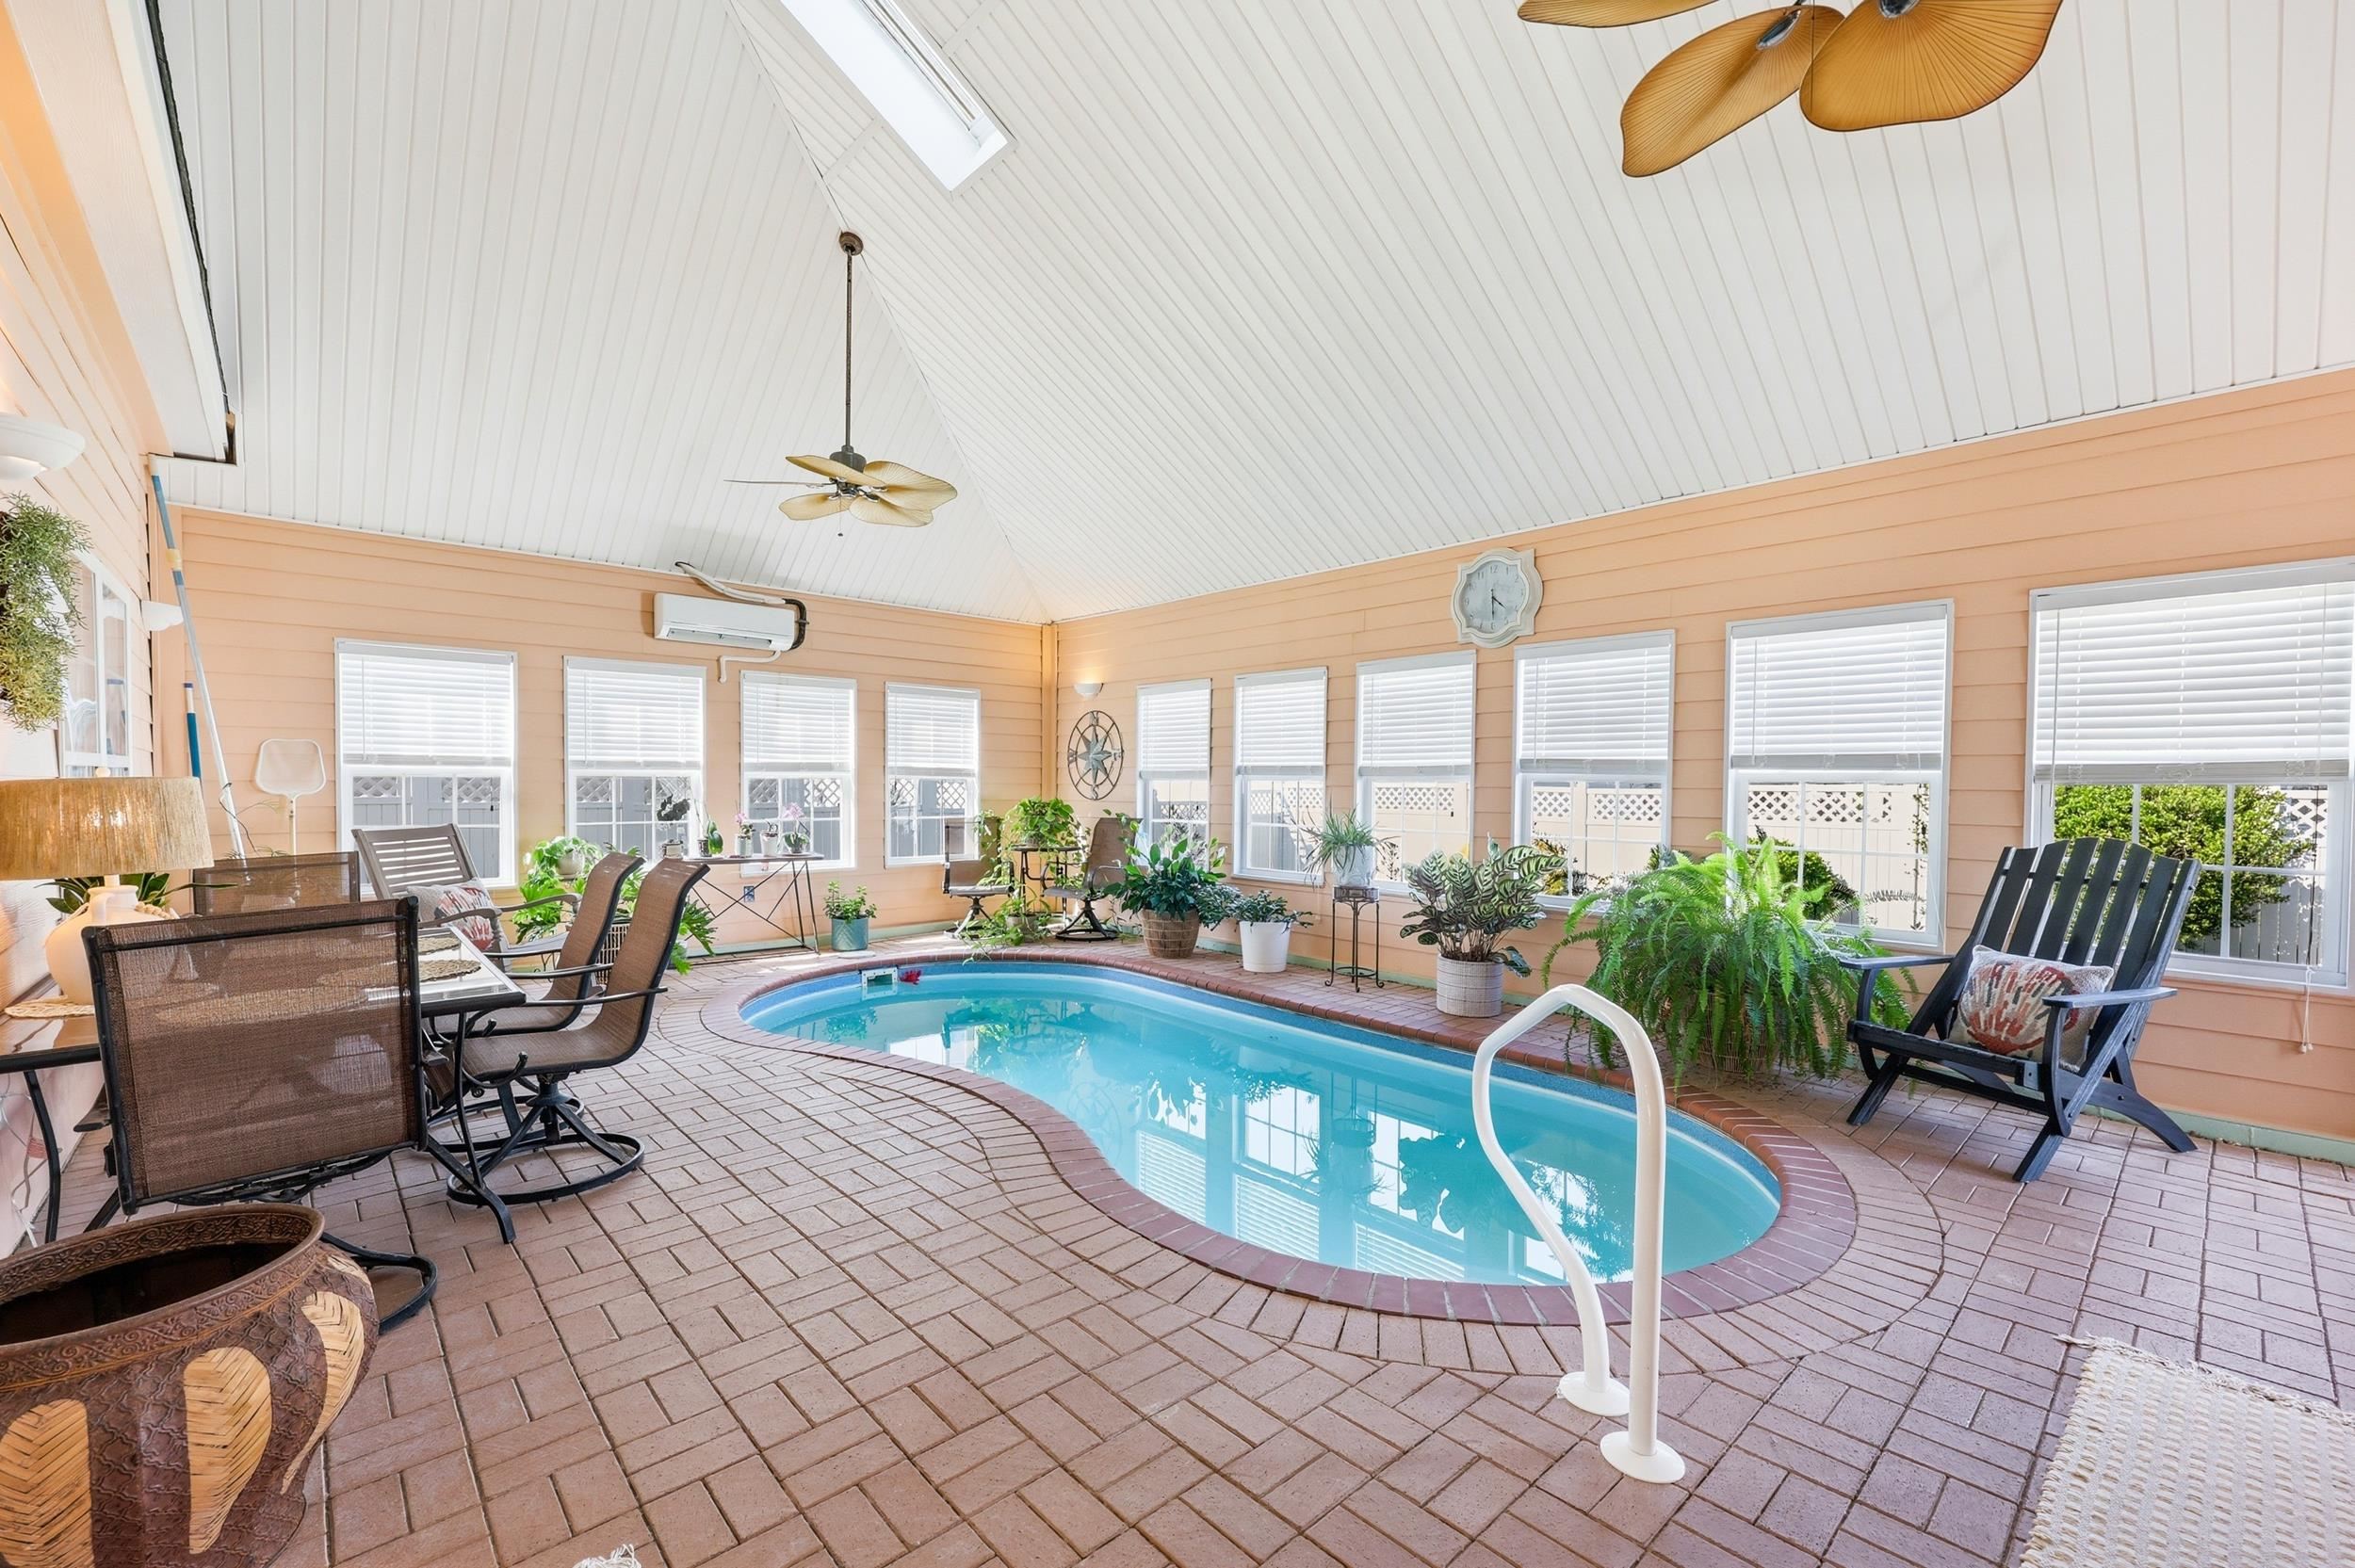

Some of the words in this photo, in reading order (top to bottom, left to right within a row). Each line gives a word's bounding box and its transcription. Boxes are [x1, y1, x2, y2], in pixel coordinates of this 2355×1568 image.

[1490, 564, 1499, 574] 12
[1477, 572, 1484, 580] 11
[1514, 574, 1519, 583] 2
